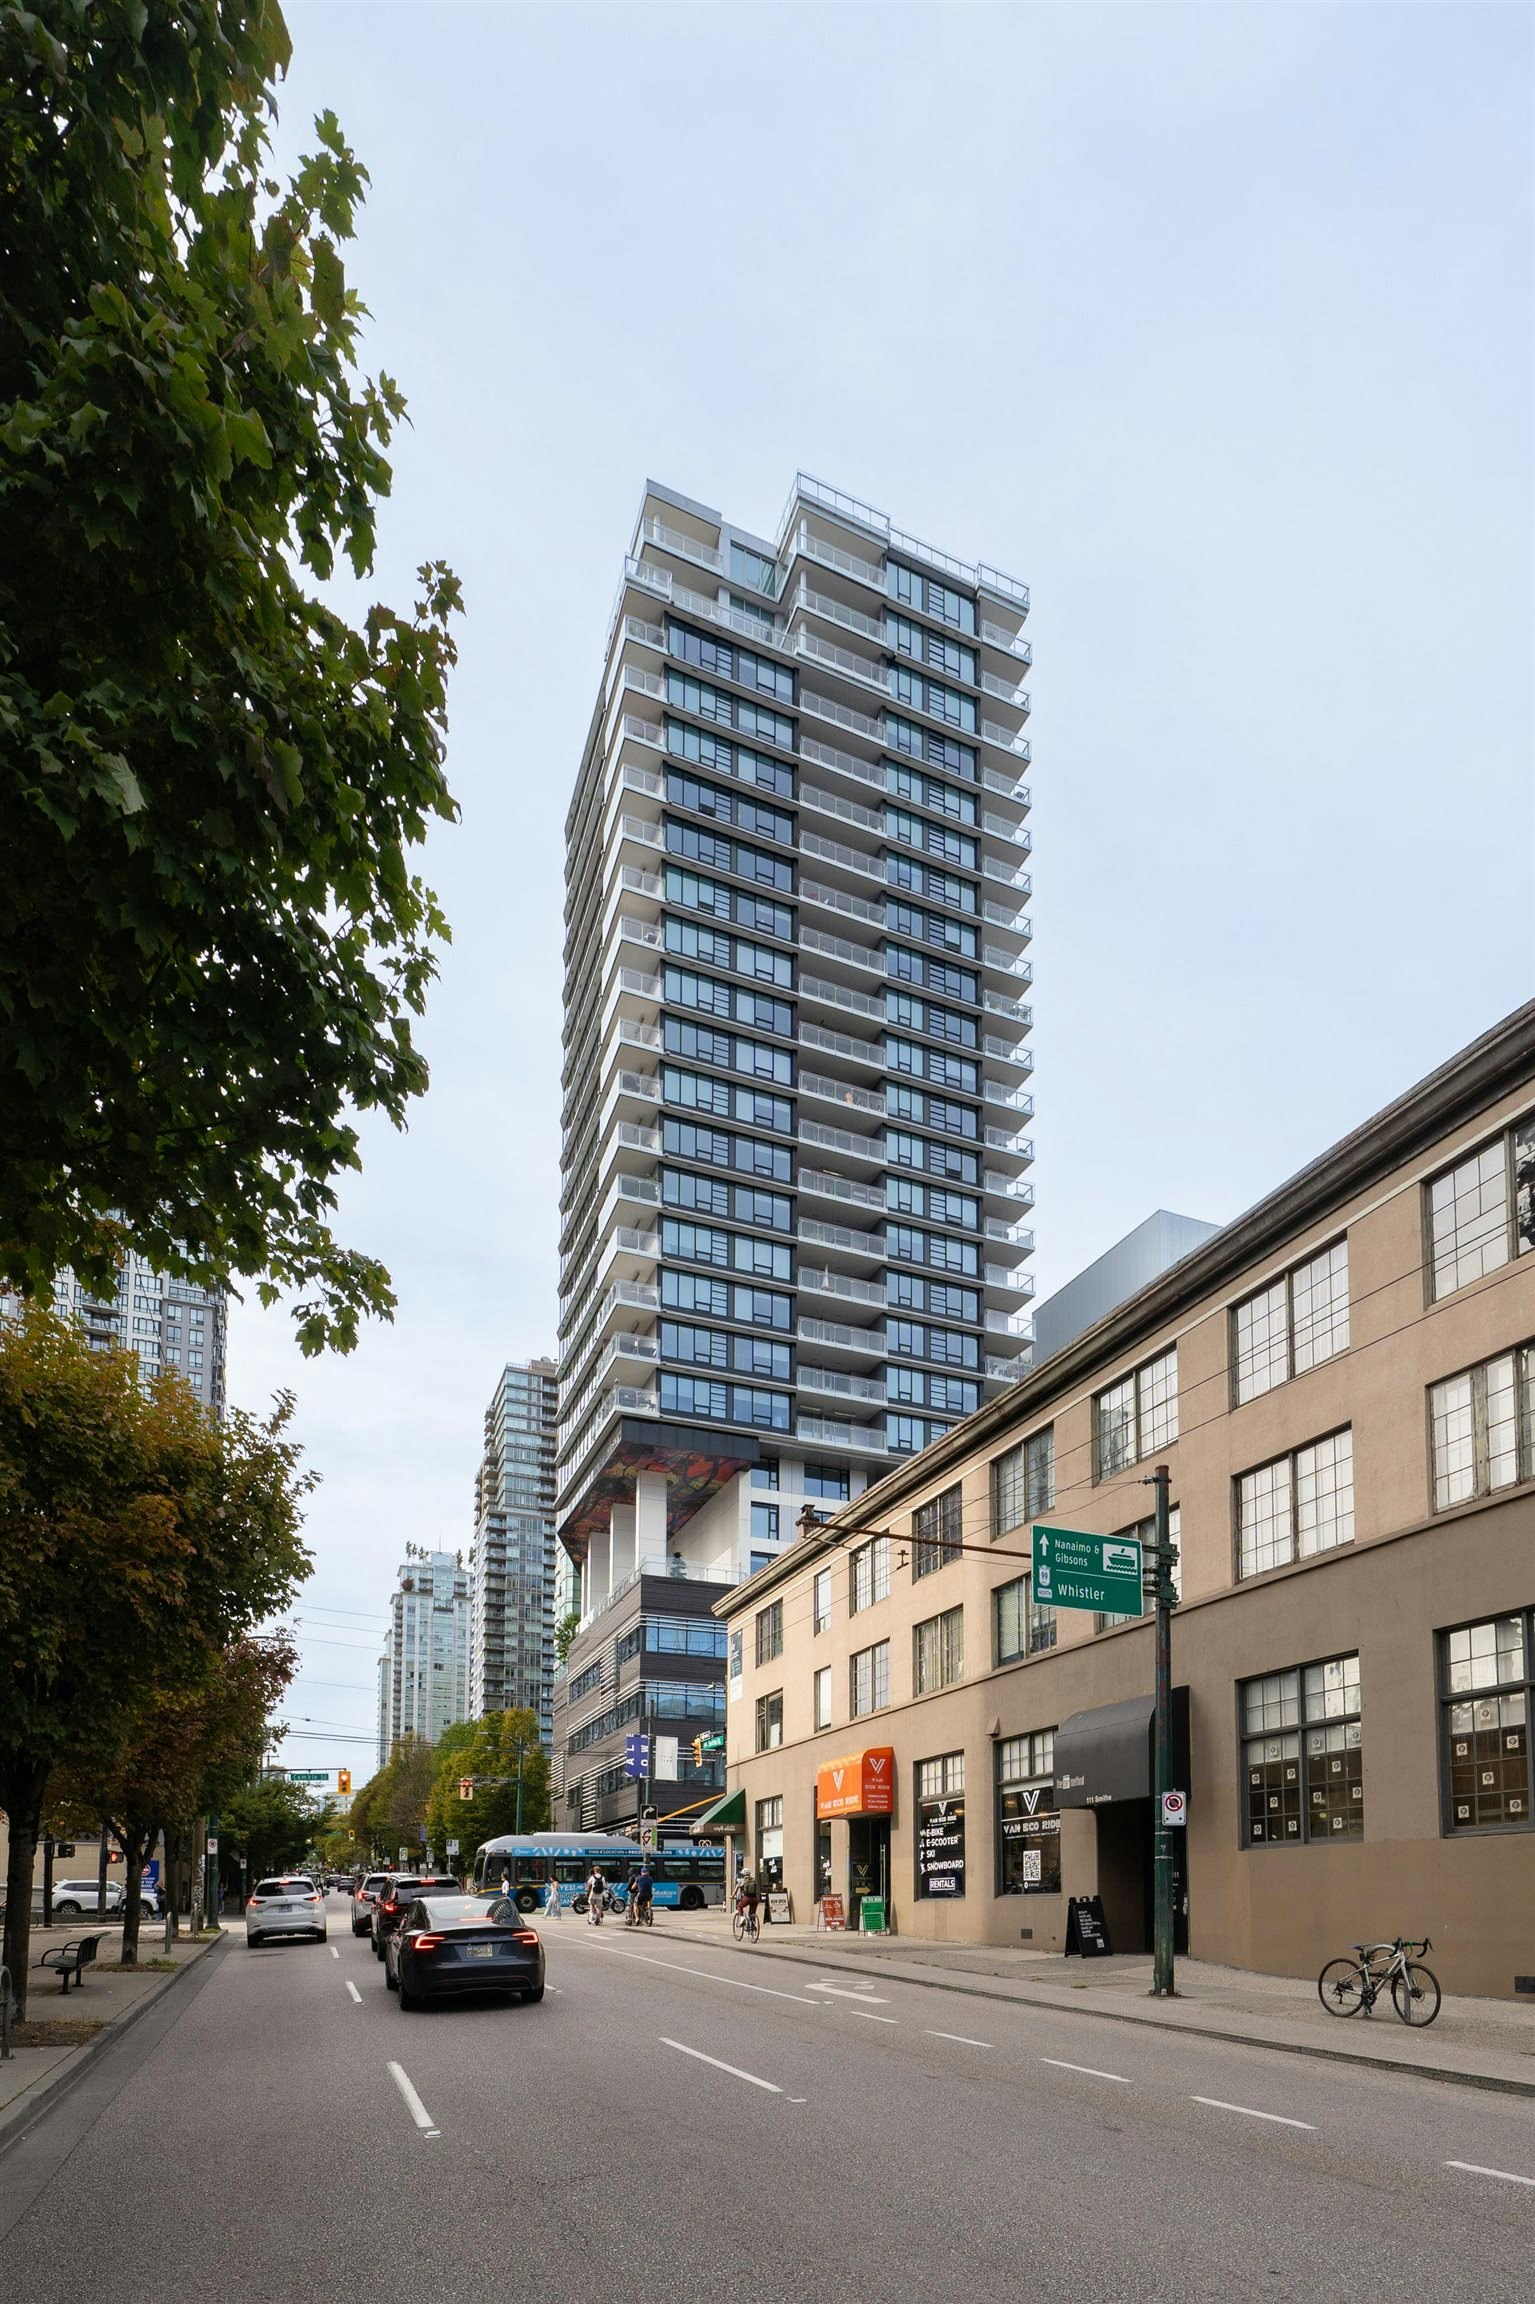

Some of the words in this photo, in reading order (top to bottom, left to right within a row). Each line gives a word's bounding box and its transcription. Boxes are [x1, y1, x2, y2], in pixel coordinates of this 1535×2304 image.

[1055, 1539, 1091, 1553] Nanaimo
[1094, 1545, 1100, 1554] &
[1056, 1553, 1088, 1566] Gibsons
[1041, 1572, 1048, 1580] 99
[1058, 1584, 1104, 1600] Whistler
[1095, 1794, 1112, 1802] Smithe
[926, 1827, 944, 1837] E-BIKE
[1004, 1824, 1021, 1834] VAN
[1022, 1822, 1039, 1832] ECO
[926, 1836, 958, 1847] E-SCOOTER
[926, 1850, 936, 1858] SKI
[926, 1860, 964, 1871] SNOWBOARD
[930, 1880, 955, 1888] RENTALS
